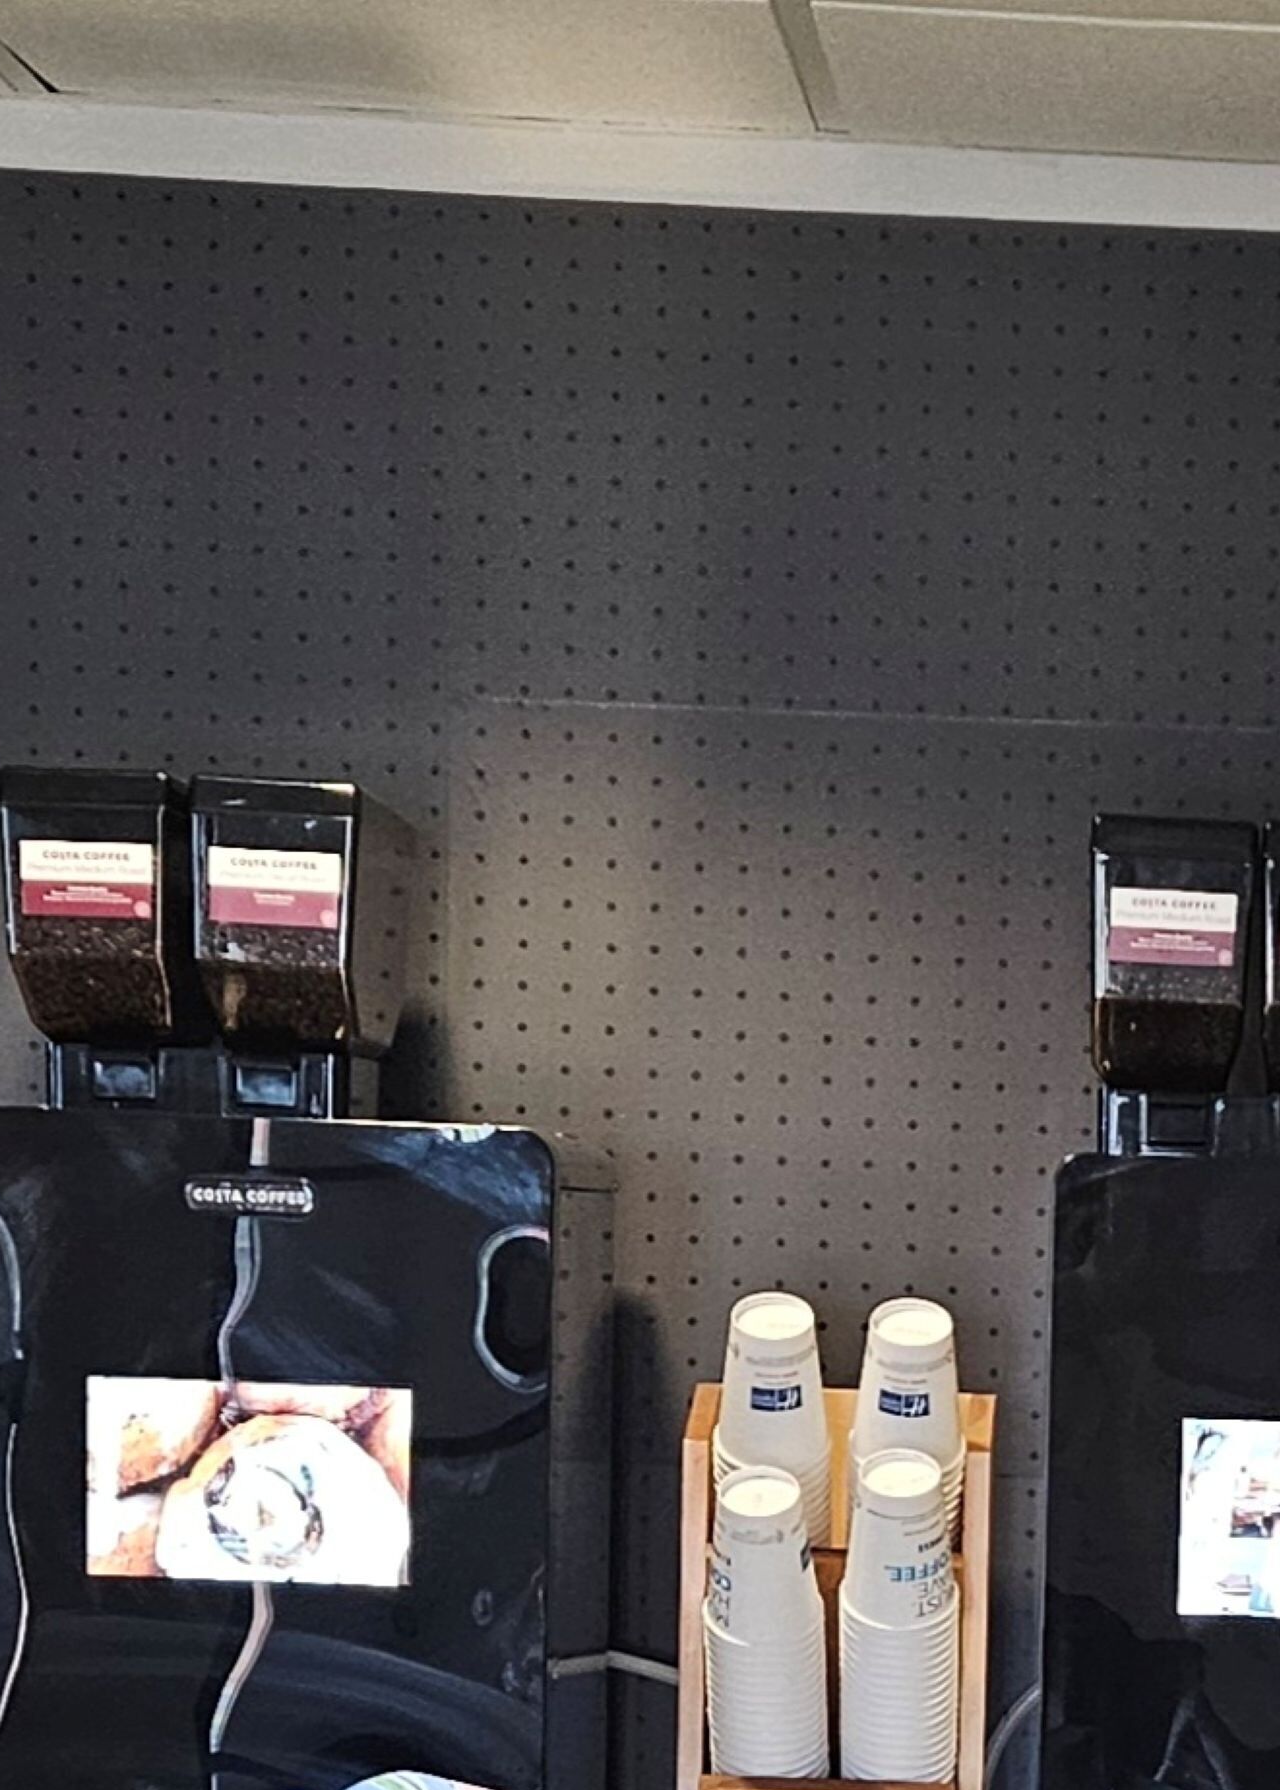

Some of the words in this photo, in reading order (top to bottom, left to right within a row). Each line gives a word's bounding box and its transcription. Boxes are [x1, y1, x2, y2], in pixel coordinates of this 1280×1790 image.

[42, 849, 80, 860] COSTA
[83, 851, 130, 861] COFFEE
[230, 857, 268, 868] COSTA
[272, 860, 318, 870] COFFEE
[193, 1187, 243, 1203] COSTA
[245, 1189, 305, 1205] COFFEE
